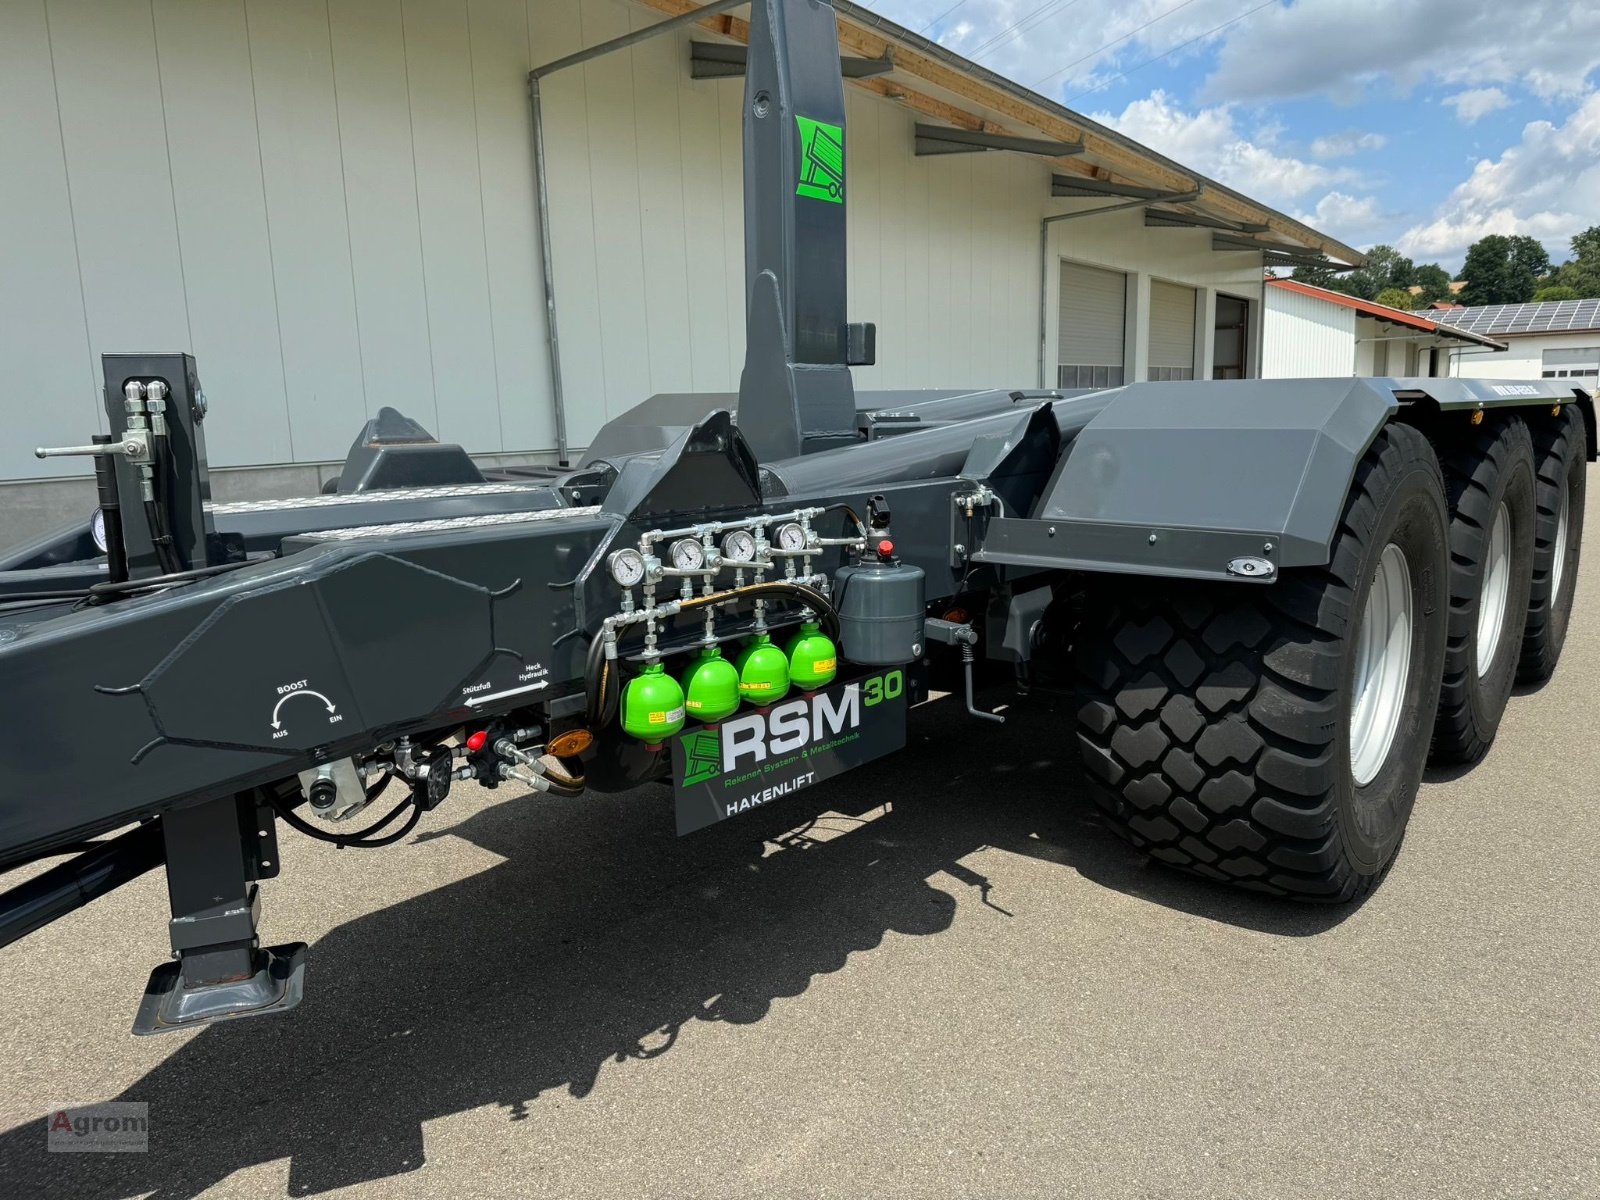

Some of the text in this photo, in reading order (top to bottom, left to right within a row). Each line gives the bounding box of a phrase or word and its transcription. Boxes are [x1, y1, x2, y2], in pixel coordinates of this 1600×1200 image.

[525, 662, 541, 672] Heck
[518, 668, 549, 682] Hydraulik
[276, 679, 308, 695] BOOST
[462, 681, 492, 695] Stützfuß
[329, 714, 343, 724] EIN
[721, 670, 903, 773] RSM 30
[272, 729, 289, 740] AUS
[763, 756, 800, 773] System-
[801, 750, 808, 759] &
[810, 731, 860, 757] Metalltechnik
[726, 771, 815, 817] HAKENLIFT
